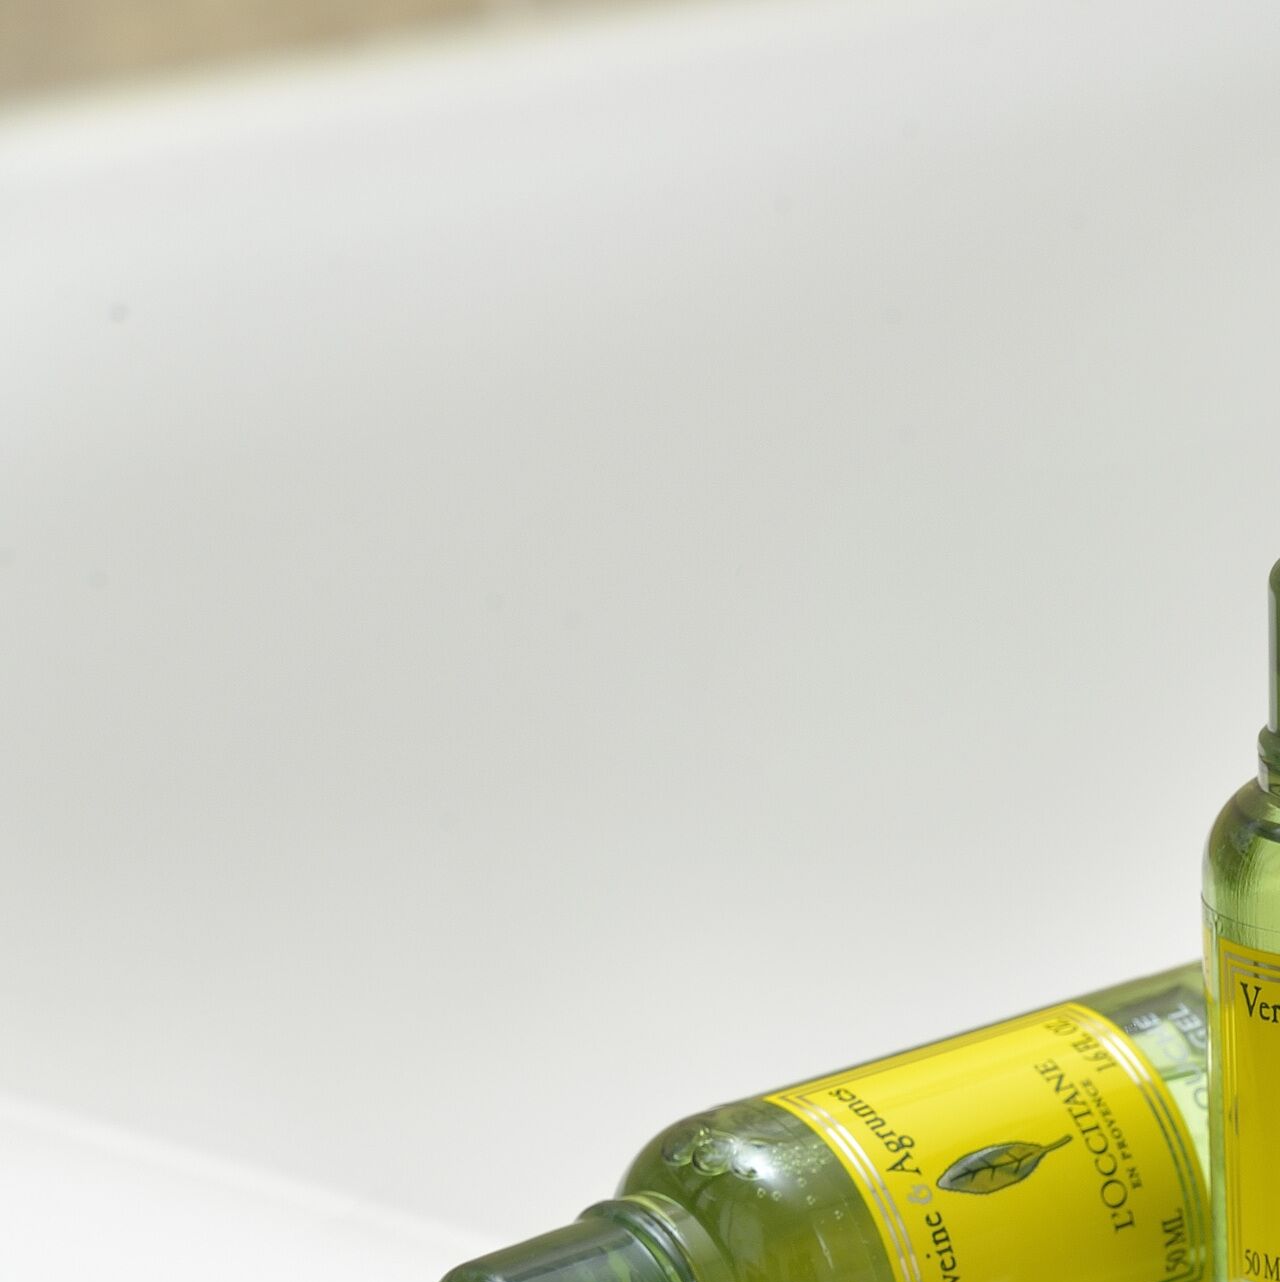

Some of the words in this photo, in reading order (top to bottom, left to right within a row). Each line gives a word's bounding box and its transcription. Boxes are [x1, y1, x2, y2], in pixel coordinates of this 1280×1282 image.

[828, 1087, 922, 1176] Agrumes
[1080, 1078, 1133, 1161] PROVENCE
[1126, 1166, 1143, 1190] EN
[907, 1184, 933, 1206] &
[1161, 1207, 1188, 1248] ML
[1164, 1247, 1187, 1273] 50
[1244, 1248, 1261, 1276] 50
